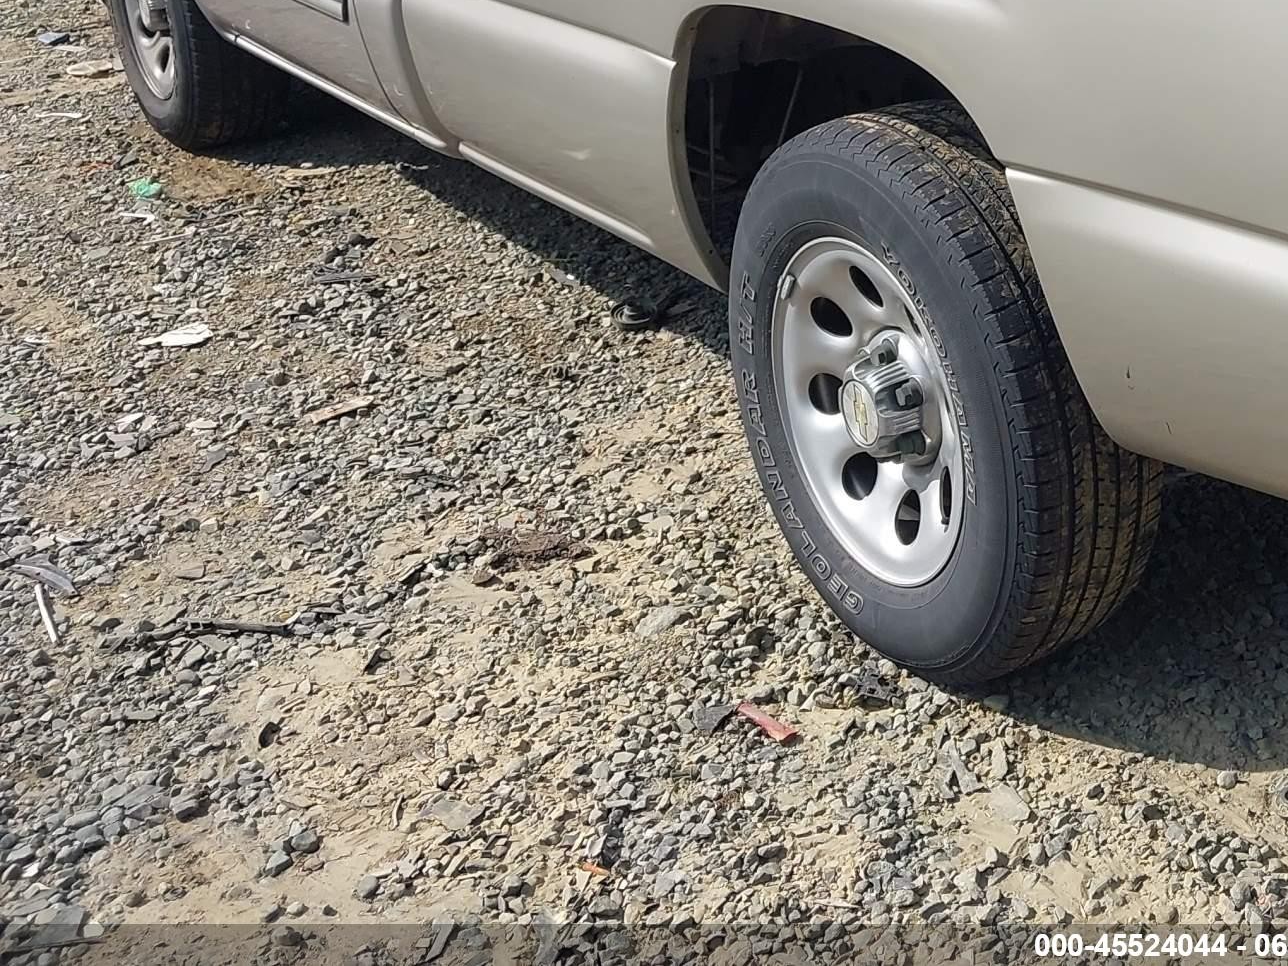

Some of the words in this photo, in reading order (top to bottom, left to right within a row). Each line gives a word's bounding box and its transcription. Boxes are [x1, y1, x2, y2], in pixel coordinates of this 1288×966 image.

[738, 270, 756, 355] H/T
[881, 241, 977, 506] YOKOHAMA
[741, 368, 865, 616] GEOLANDAR
